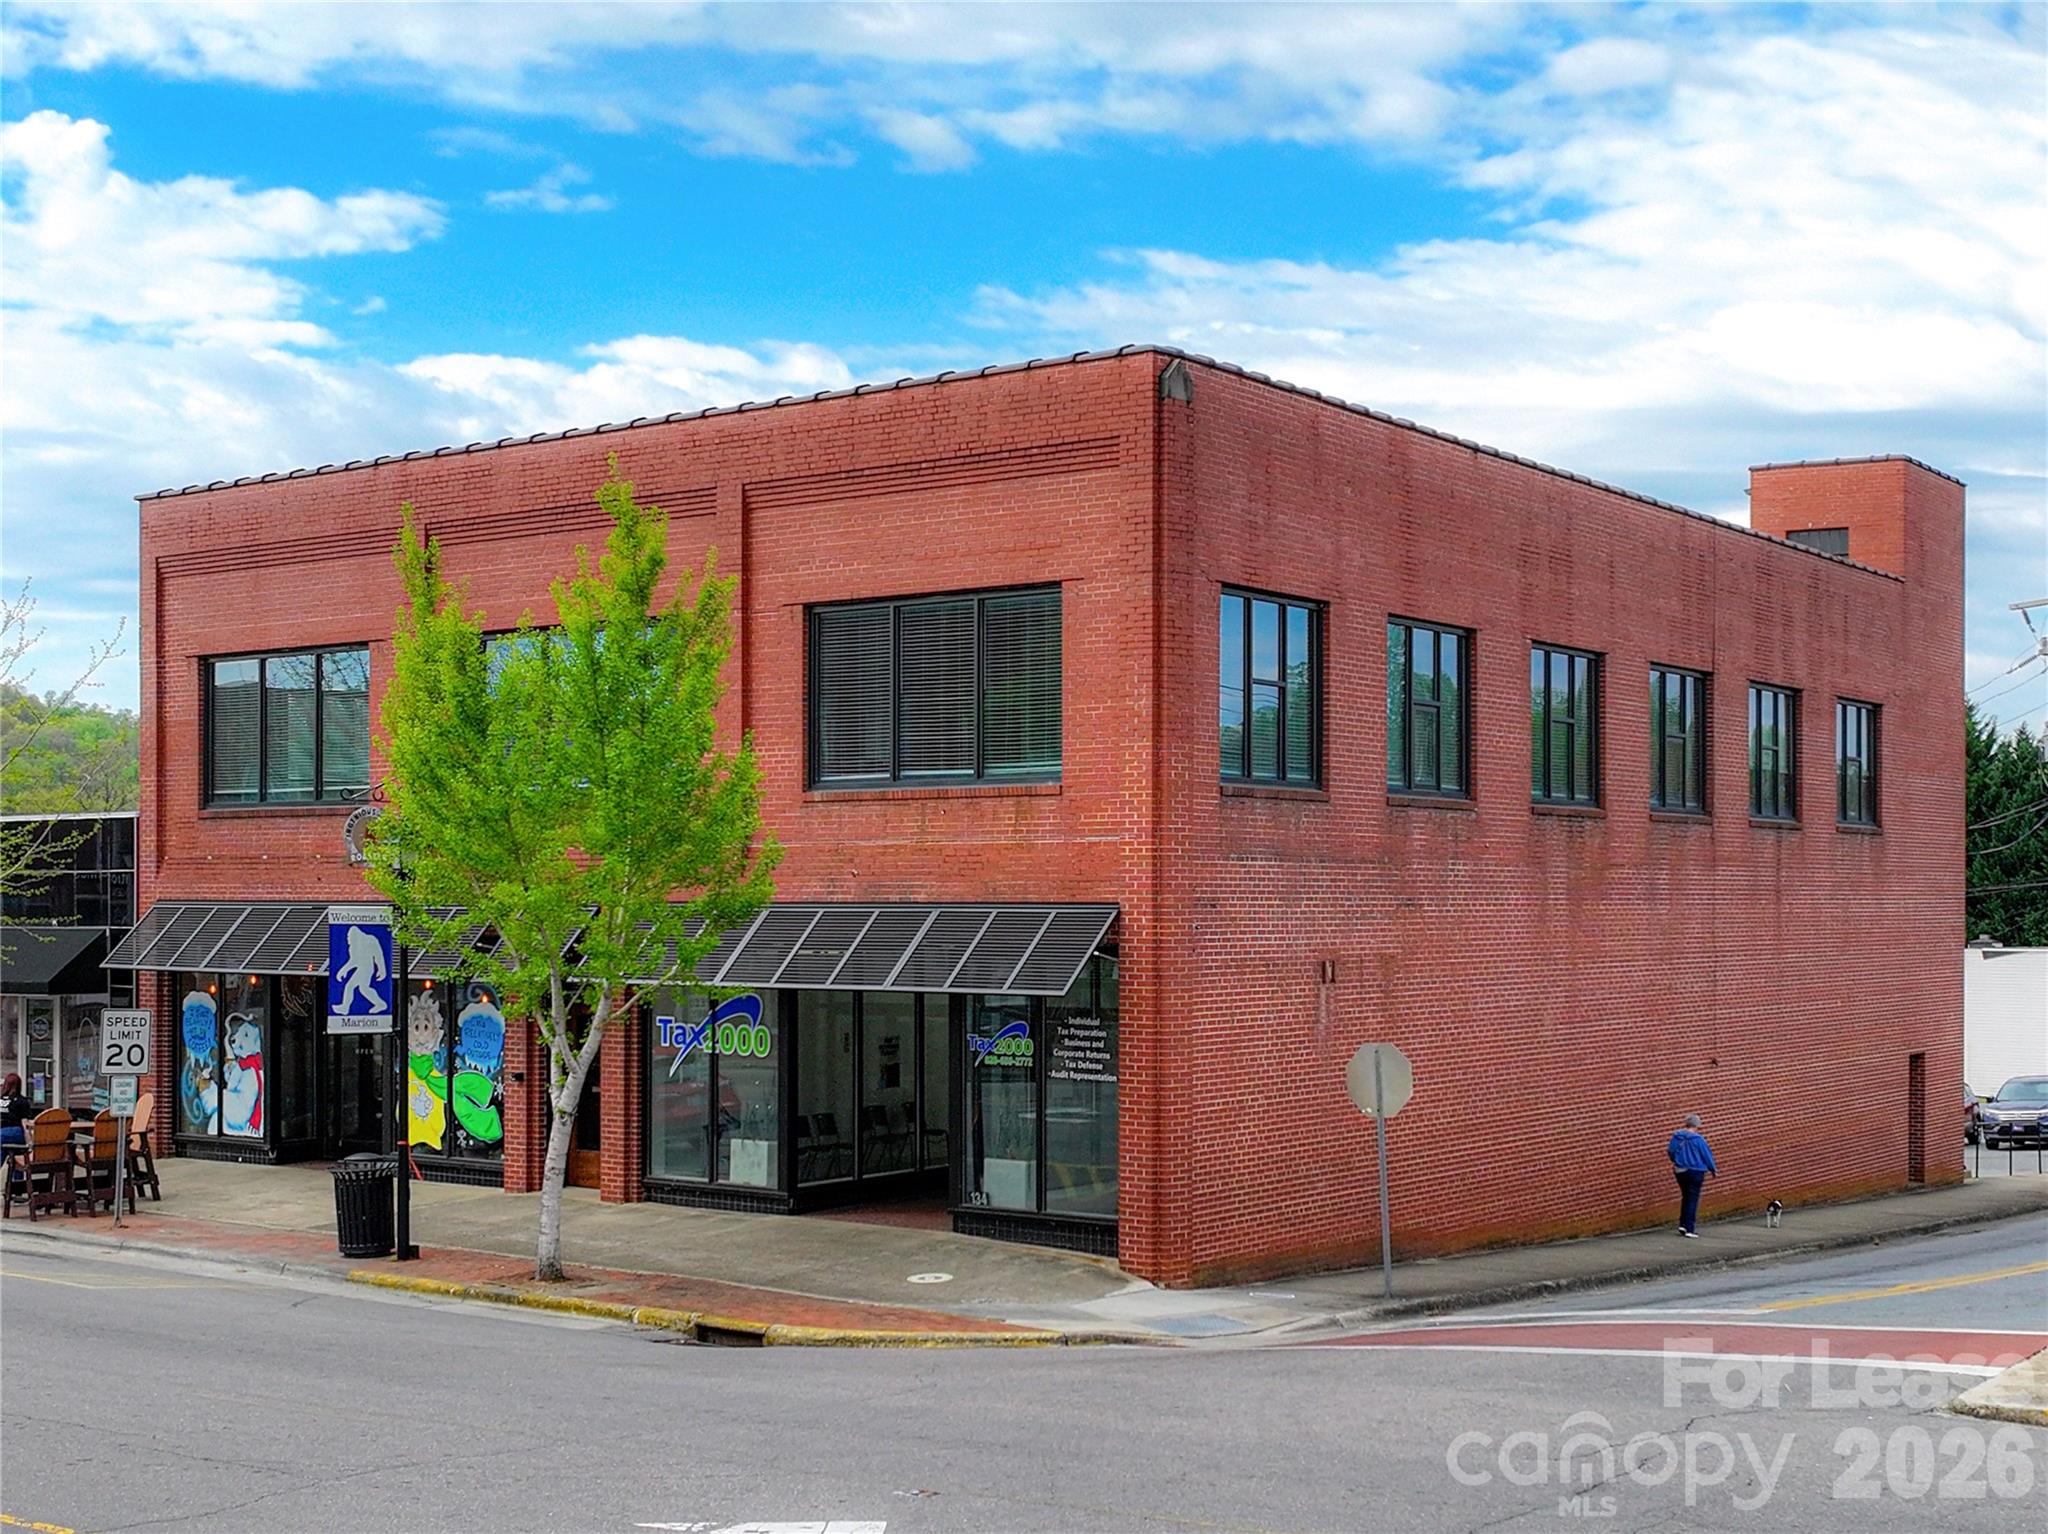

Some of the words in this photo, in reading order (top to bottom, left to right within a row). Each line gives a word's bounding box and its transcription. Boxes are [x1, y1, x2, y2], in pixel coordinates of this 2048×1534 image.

[330, 912, 377, 922] Welcome
[379, 914, 391, 922] to
[106, 1017, 147, 1027] SPEED
[341, 1018, 378, 1027] Marion
[1068, 1016, 1100, 1025] Individual
[110, 1030, 142, 1040] LIMIT
[1057, 1027, 1069, 1035] Tax
[1070, 1028, 1107, 1037] Preparation
[967, 1029, 1034, 1059] Tax2000
[1064, 1038, 1091, 1047] Business
[1091, 1040, 1104, 1048] and
[105, 1044, 145, 1066] 20
[1053, 1048, 1085, 1058] Corporate
[1085, 1050, 1110, 1060] Returns
[1064, 1060, 1076, 1068] Tax
[1077, 1061, 1104, 1070] Defense
[1051, 1070, 1069, 1079] Audit
[1069, 1071, 1117, 1082] Representation
[970, 1191, 988, 1207] 134
